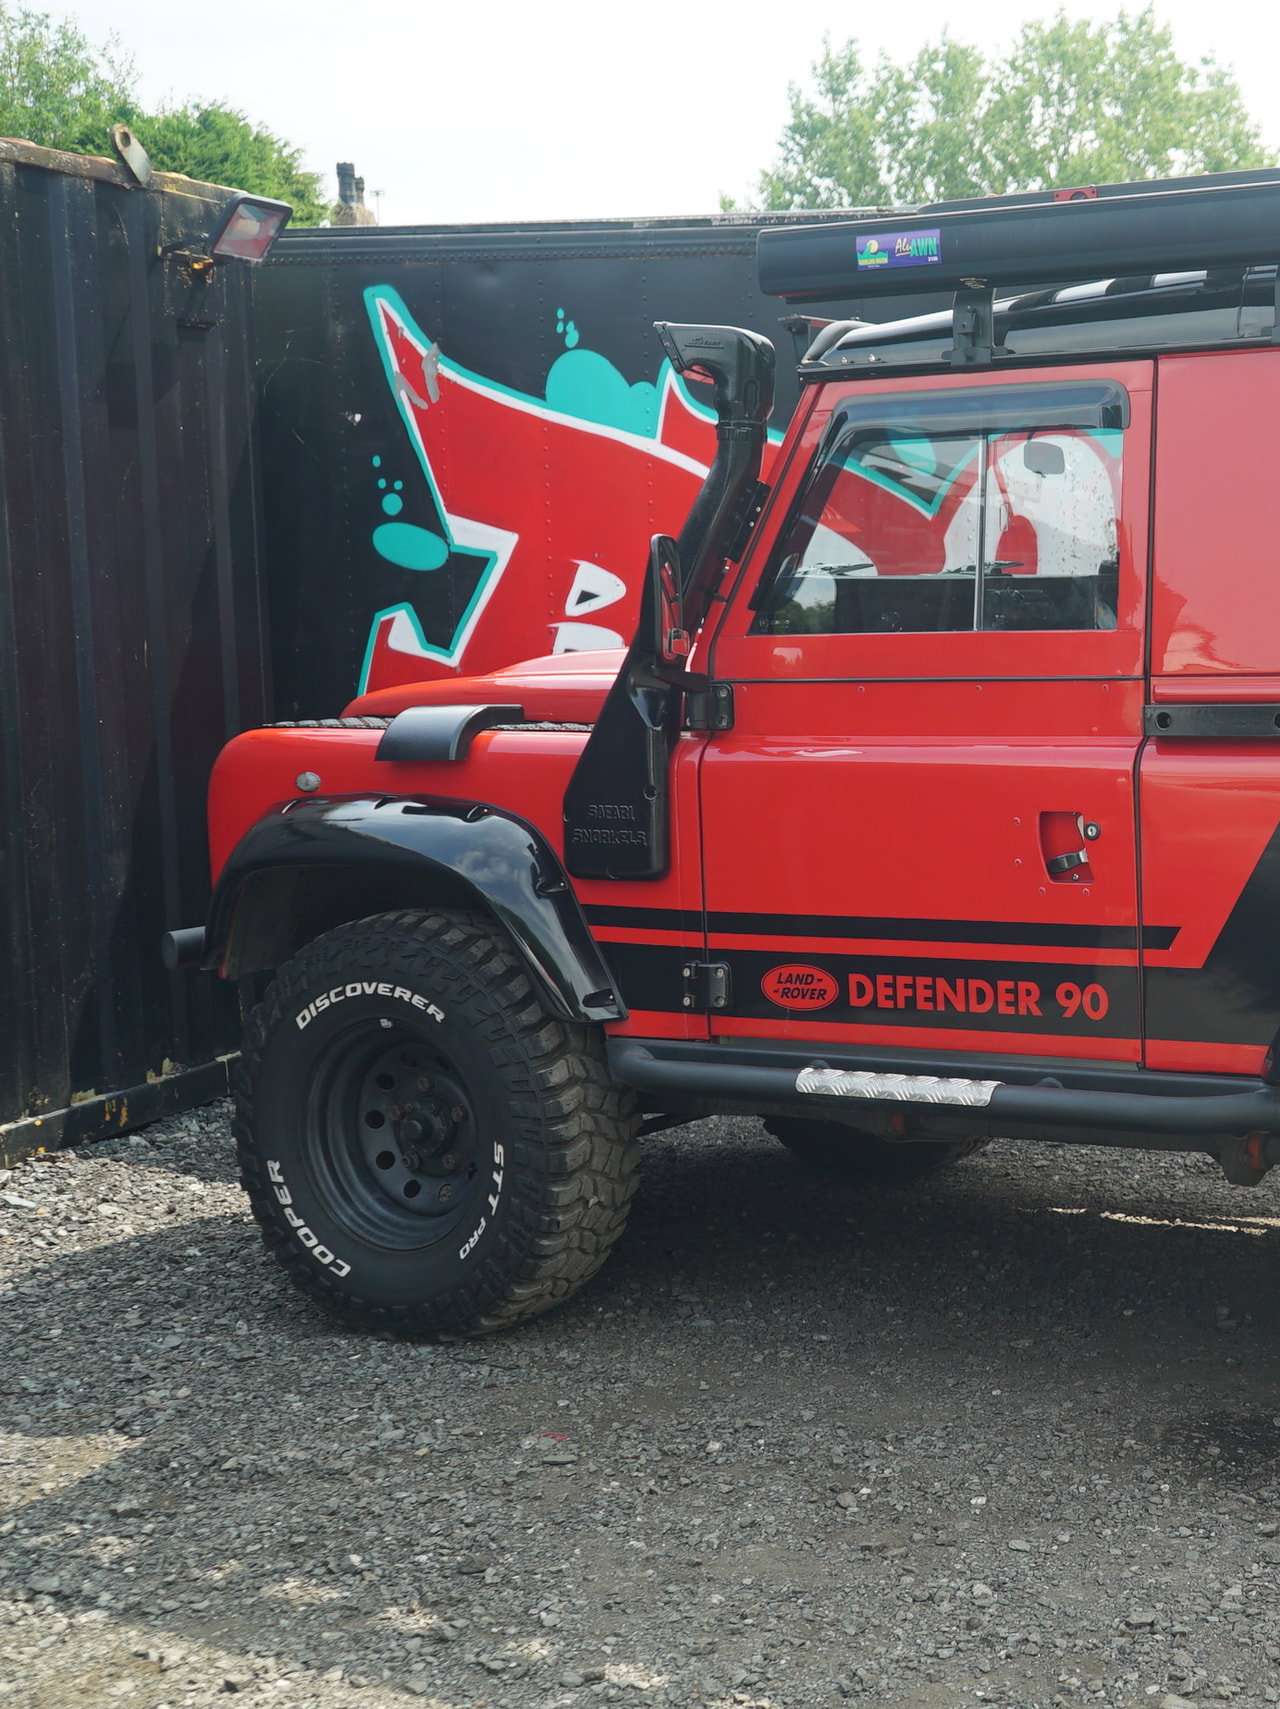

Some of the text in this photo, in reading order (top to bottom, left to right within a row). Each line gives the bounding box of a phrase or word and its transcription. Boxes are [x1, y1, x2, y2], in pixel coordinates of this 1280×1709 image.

[295, 981, 445, 1030] DISCOVERER
[848, 973, 1109, 1021] DEFENDER 90
[266, 1159, 351, 1277] COOPER
[459, 1141, 504, 1260] STT PRO
